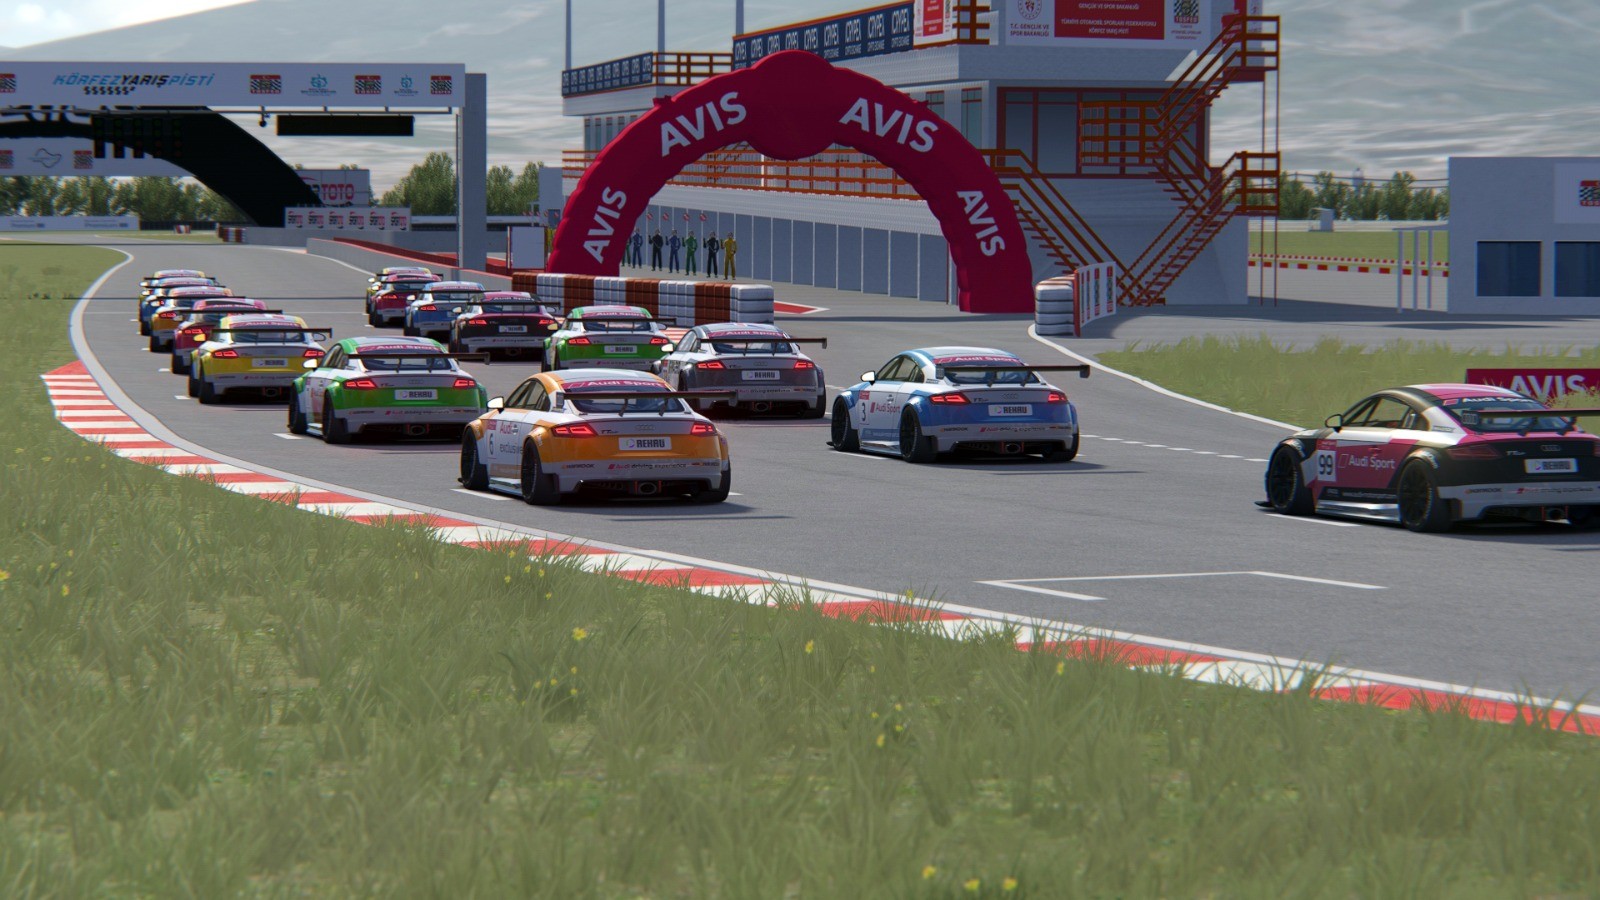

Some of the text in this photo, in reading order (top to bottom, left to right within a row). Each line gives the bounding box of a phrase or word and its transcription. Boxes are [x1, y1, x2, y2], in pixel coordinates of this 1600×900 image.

[660, 92, 746, 158] AVIS
[838, 98, 939, 152] AVIS
[583, 186, 627, 264] AVIS
[956, 190, 1006, 256] AVIS
[1510, 375, 1586, 401] AVIS
[862, 402, 866, 422] 3
[500, 421, 512, 434] Audi
[489, 433, 493, 455] 6
[636, 439, 665, 448] REHAU
[1318, 454, 1332, 475] 99
[1348, 455, 1396, 470] Audi Sport
